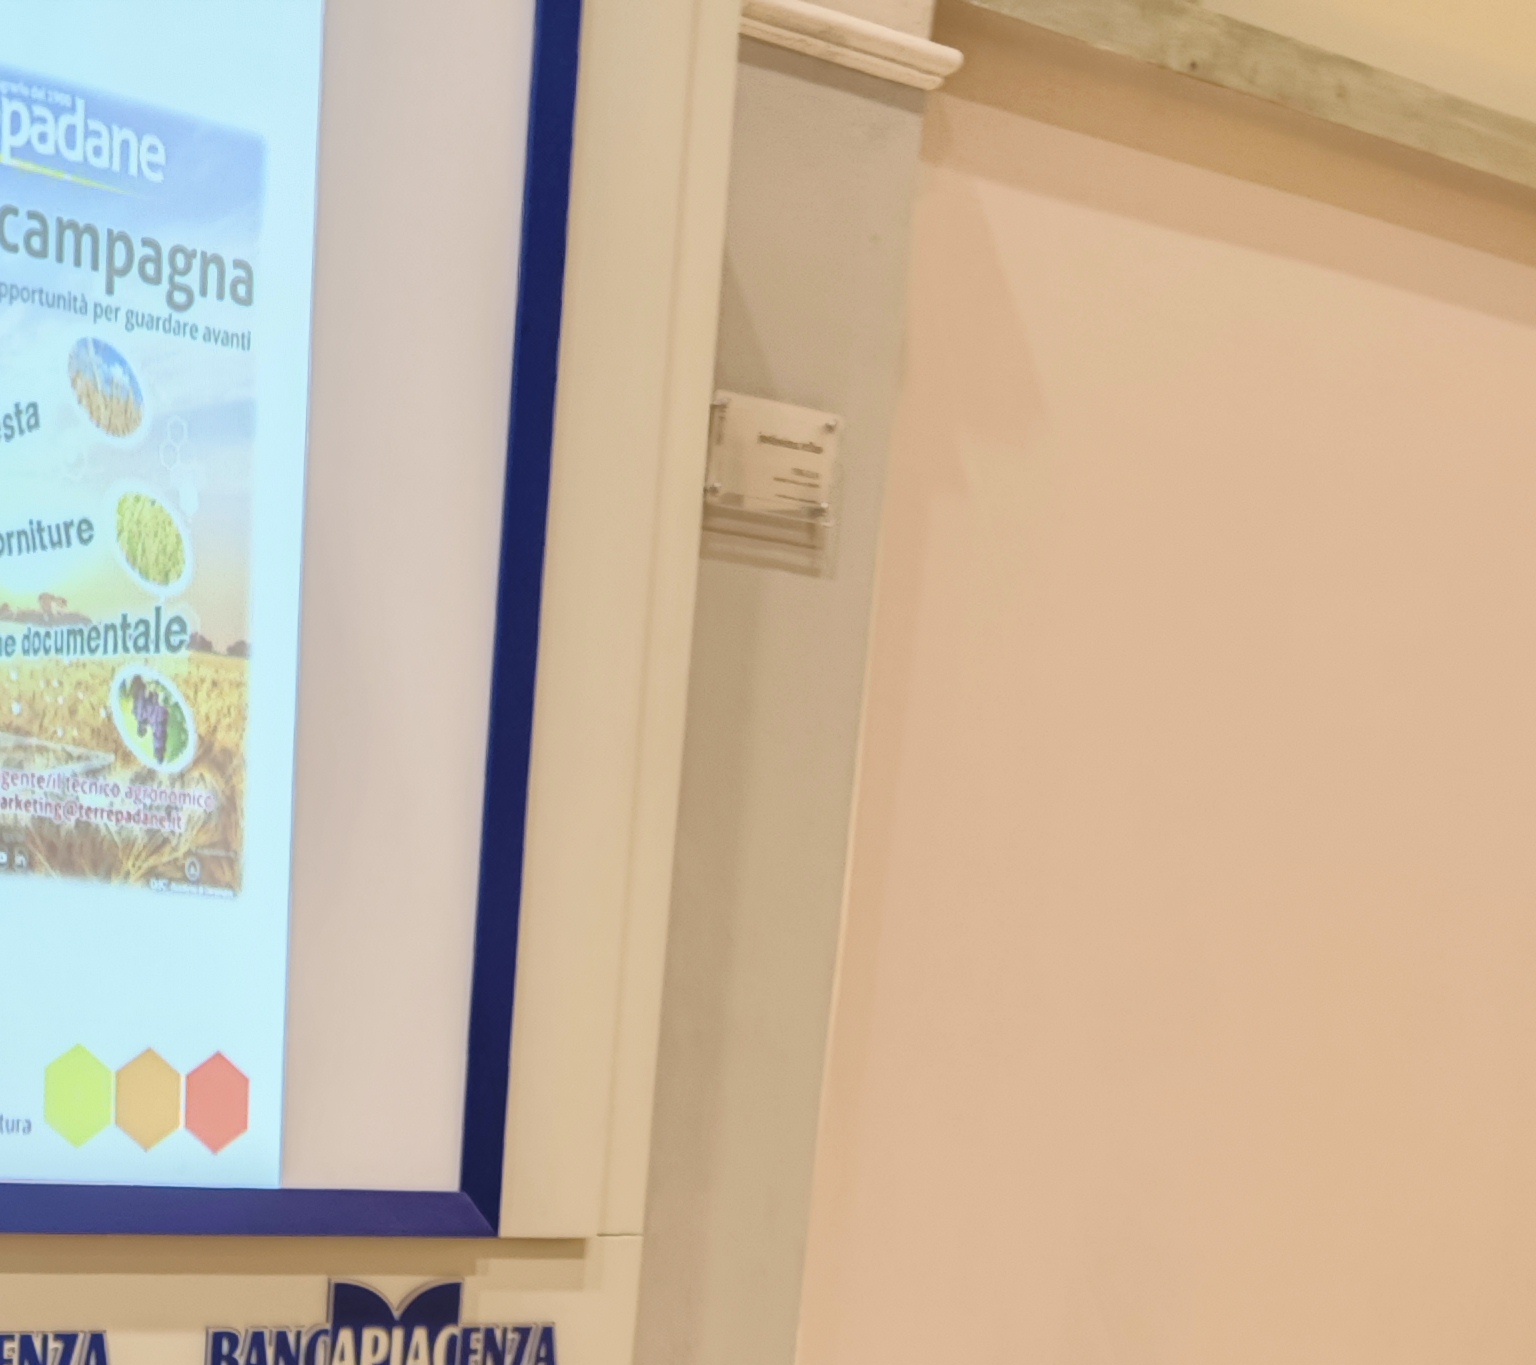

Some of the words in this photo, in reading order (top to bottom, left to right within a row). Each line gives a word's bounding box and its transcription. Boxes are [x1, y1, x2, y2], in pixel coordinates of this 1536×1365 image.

[93, 299, 122, 325] per
[124, 308, 199, 342] guardare
[202, 325, 252, 352] avanti
[20, 605, 189, 658] documentale
